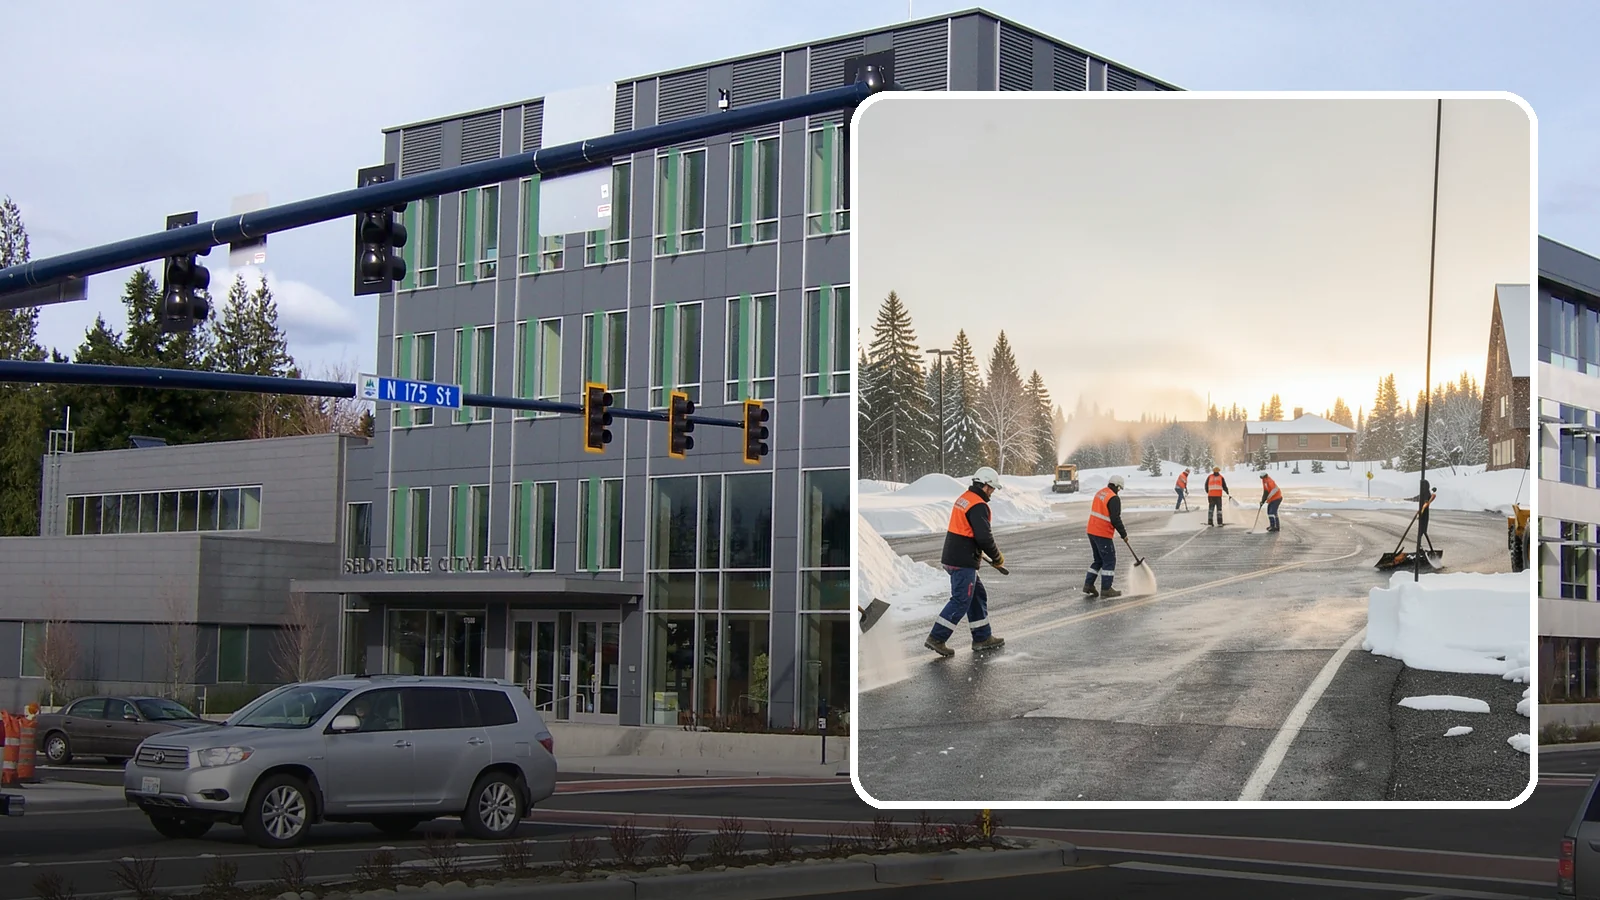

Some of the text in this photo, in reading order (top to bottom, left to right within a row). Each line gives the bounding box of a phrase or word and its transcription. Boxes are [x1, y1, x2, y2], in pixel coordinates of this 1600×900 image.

[387, 380, 451, 406] N 175 St
[343, 555, 525, 574] SHORELINE CITY HALL
